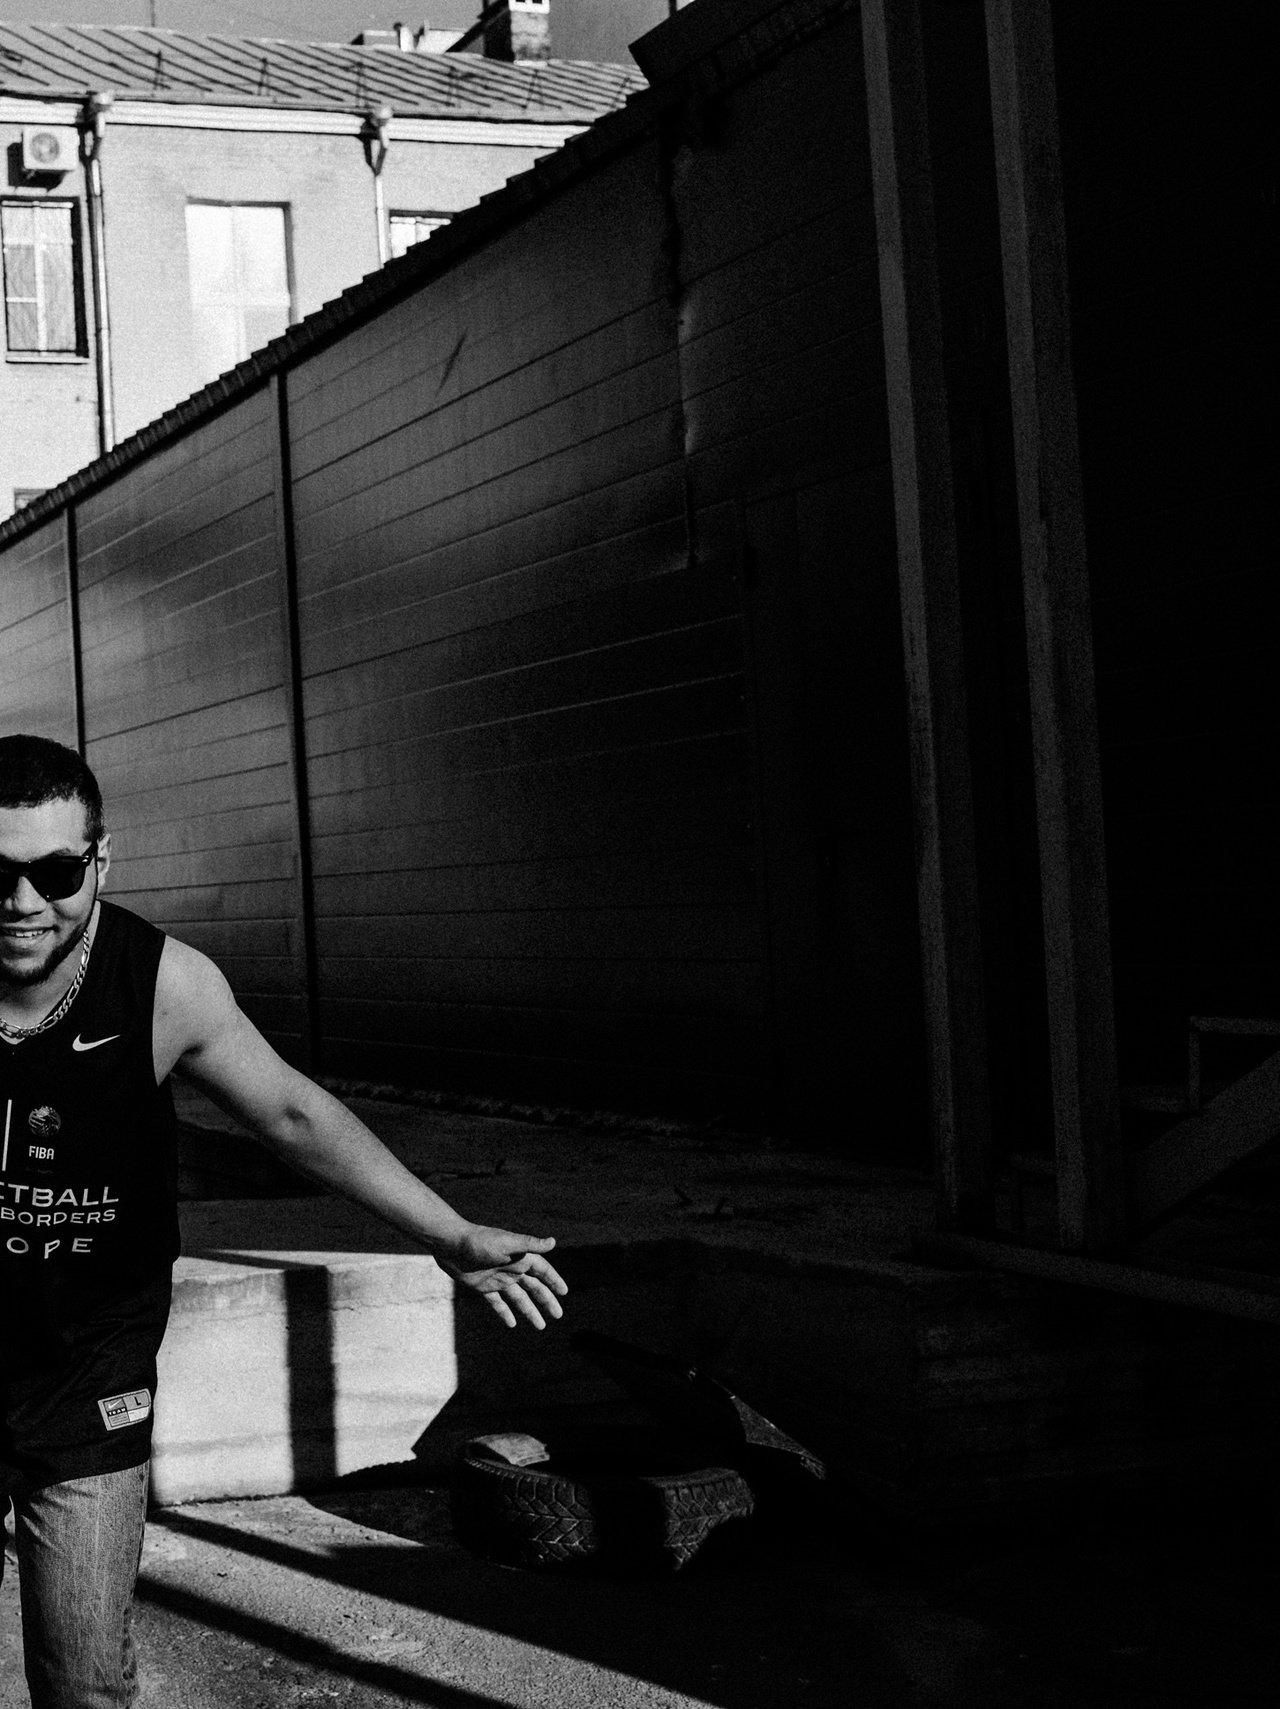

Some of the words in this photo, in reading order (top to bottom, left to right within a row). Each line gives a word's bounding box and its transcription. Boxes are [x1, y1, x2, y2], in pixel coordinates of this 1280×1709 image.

[28, 1145, 55, 1160] FIBA
[0, 1206, 117, 1227] BORDERS
[134, 1396, 141, 1406] L
